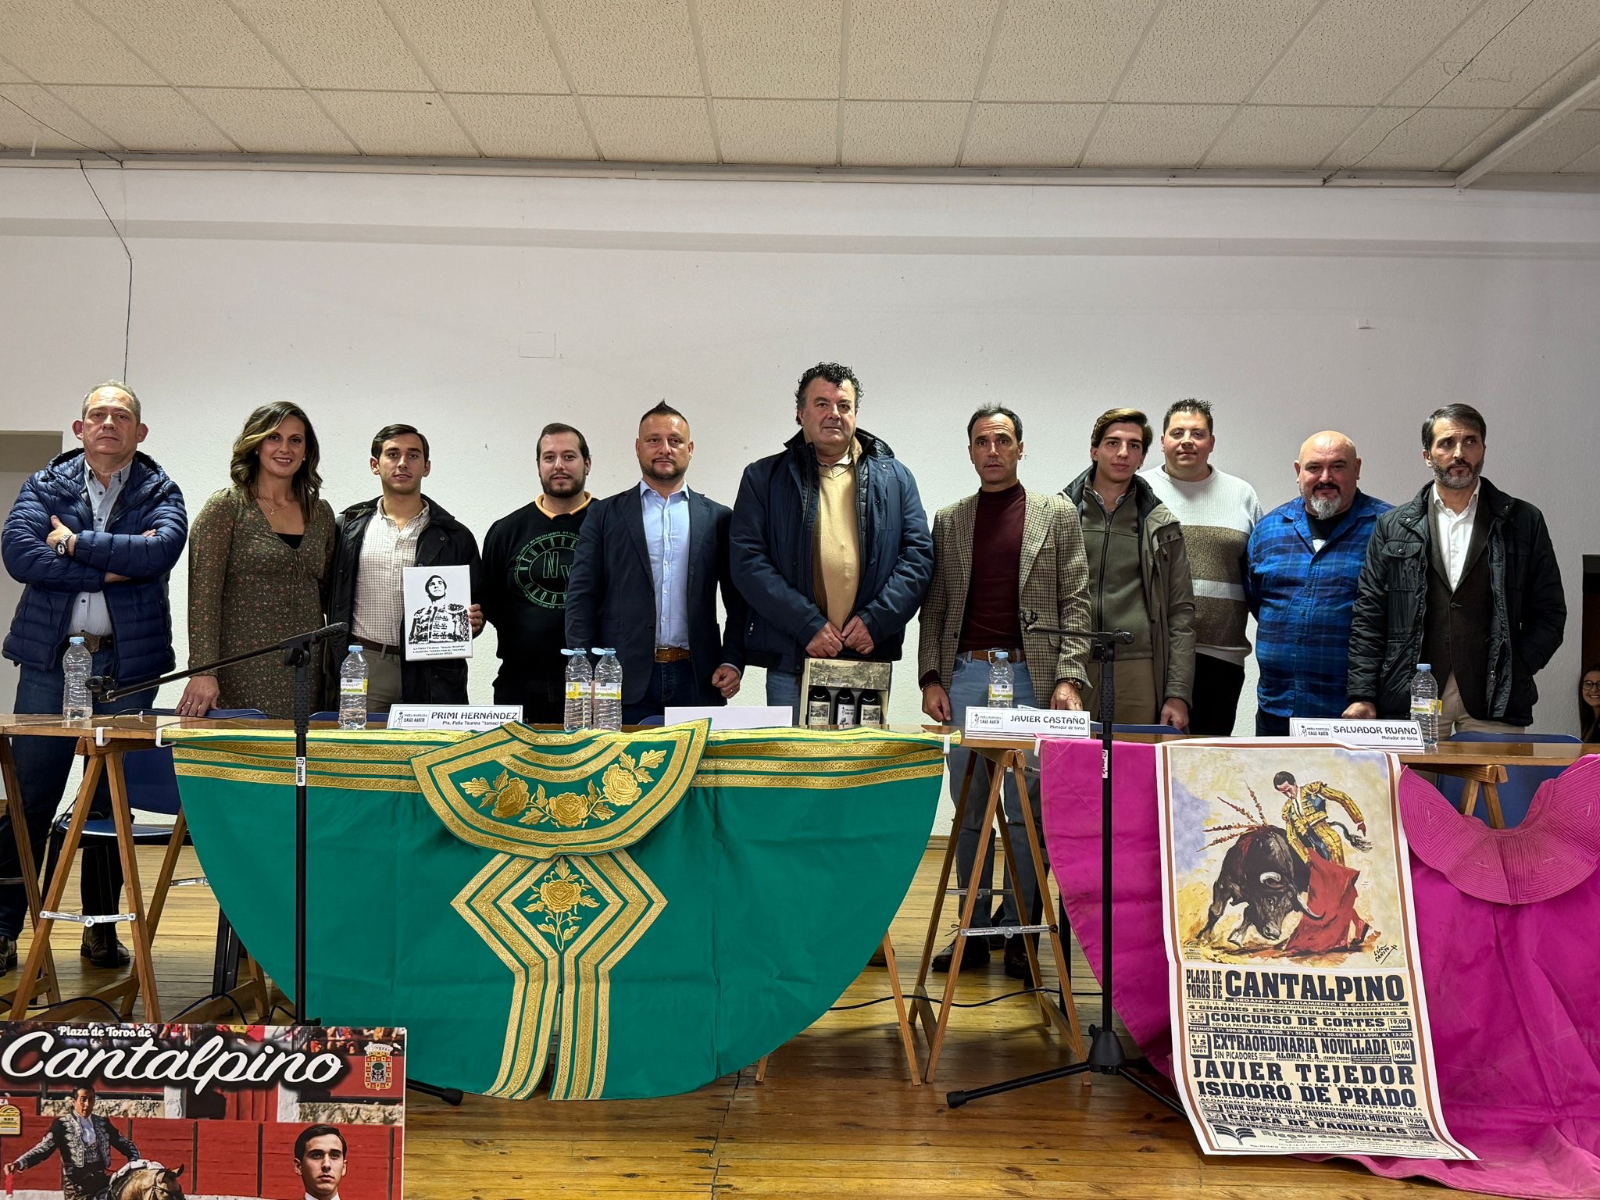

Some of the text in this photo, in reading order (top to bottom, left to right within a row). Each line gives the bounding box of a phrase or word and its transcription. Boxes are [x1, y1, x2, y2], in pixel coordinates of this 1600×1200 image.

[431, 711, 458, 720] PRIMI
[460, 710, 518, 720] HERNÁNDEZ
[1010, 715, 1041, 723] JAVIER
[1043, 715, 1086, 725] CASTAÑO
[1333, 725, 1383, 735] SALVADOR
[1384, 726, 1418, 735] RUANO
[1186, 969, 1222, 984] PLAZA DE
[1186, 984, 1222, 999] TOROS DE
[1225, 970, 1405, 1001] CANTALPINO
[1252, 1008, 1336, 1016] ESPECTACULOS
[1211, 1013, 1292, 1025] CONCURSO
[1297, 1016, 1317, 1026] DE
[1323, 1018, 1385, 1027] CORTES
[58, 1026, 151, 1039] Plaza de Toros de
[1213, 1034, 1390, 1055] EXTRAORDINARIA NOVILLADA
[0, 1030, 344, 1095] Cantalpino
[1214, 1051, 1225, 1059] SIN
[1226, 1051, 1258, 1060] PICADORES
[1194, 1059, 1415, 1085] JAVIER TEJEDOR
[1197, 1081, 1417, 1108] ISIDORO DE PRADO
[1200, 1097, 1262, 1106] ACOMPAÑADOS
[1295, 1104, 1373, 1114] CORRESPONDIENTES
[1224, 1103, 1244, 1111] GRAN
[1246, 1105, 1300, 1115] ESPECTACULO
[1302, 1110, 1404, 1124] TAURINO-COMICO-MUSICAL
[1227, 1114, 1282, 1124] CAPEA
[1288, 1119, 1310, 1127] DE
[1314, 1121, 1408, 1134] VAQUILLAS
